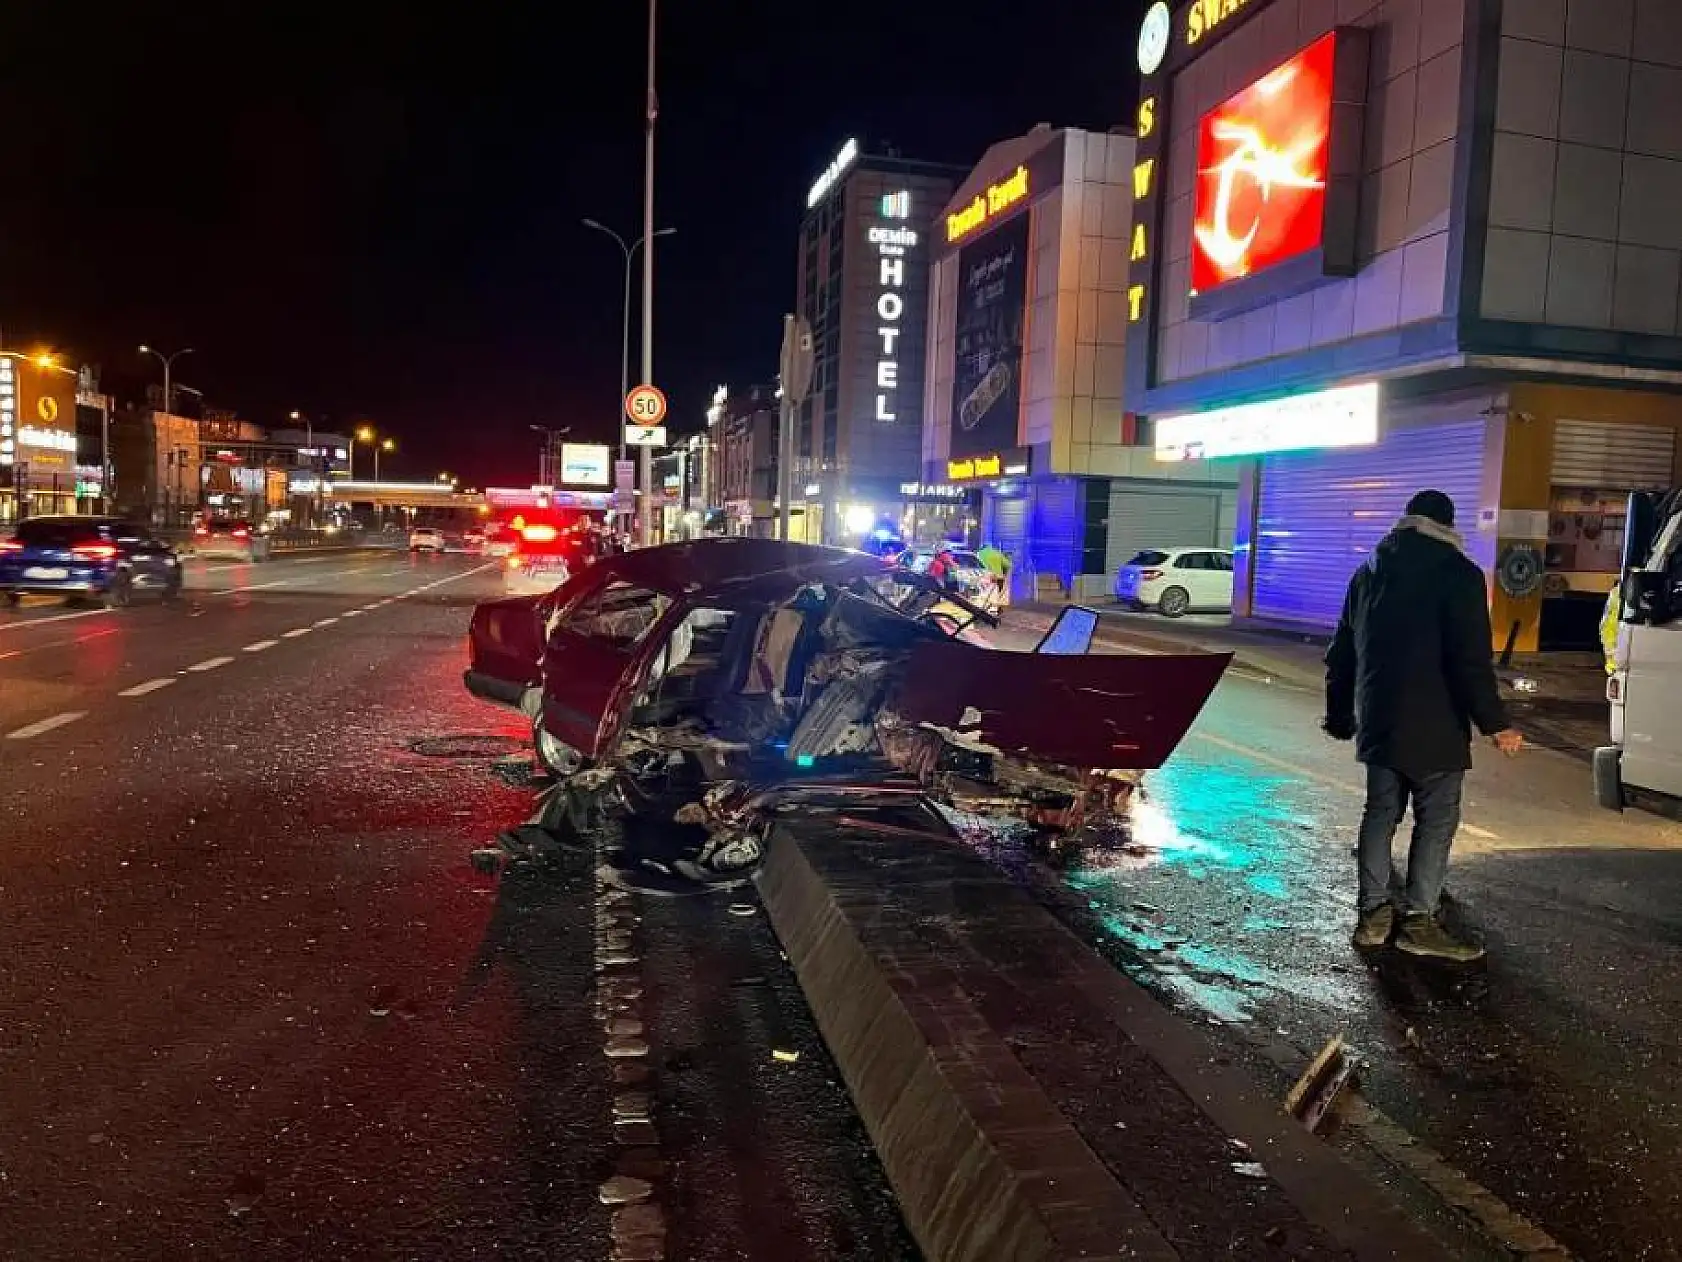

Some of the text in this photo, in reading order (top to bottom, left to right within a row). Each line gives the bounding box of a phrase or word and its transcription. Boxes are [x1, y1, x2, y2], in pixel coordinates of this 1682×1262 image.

[1127, 97, 1155, 321] SWAT
[635, 398, 655, 415] 50
[875, 258, 904, 422] HOTEL
